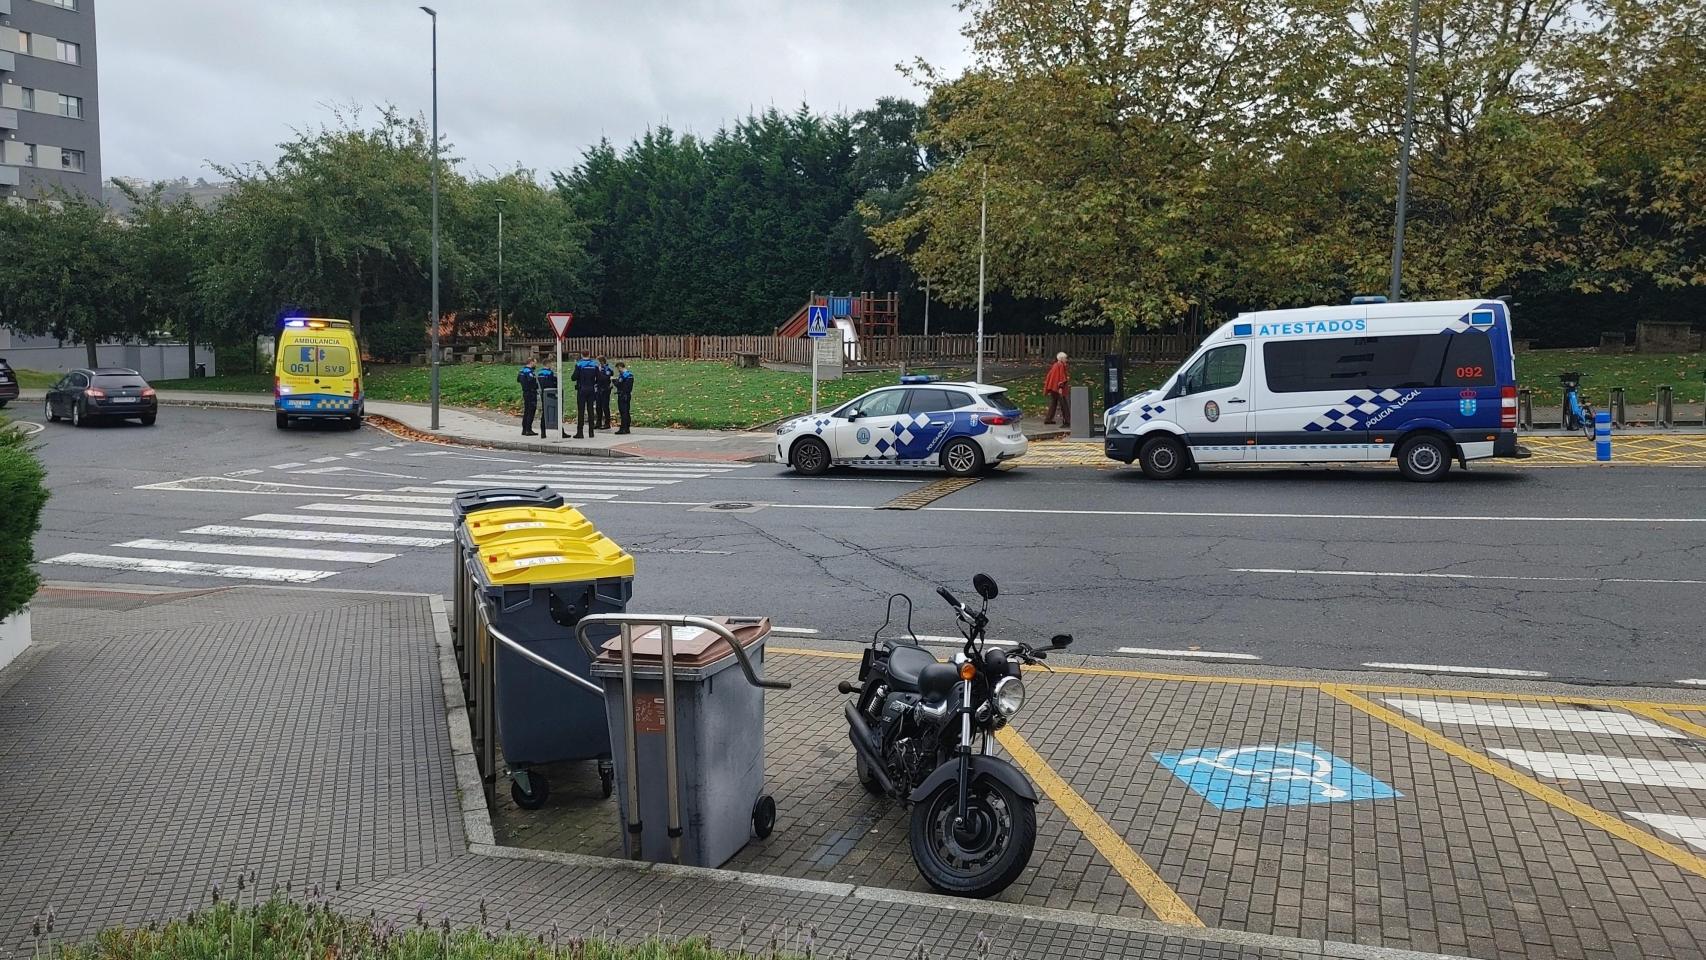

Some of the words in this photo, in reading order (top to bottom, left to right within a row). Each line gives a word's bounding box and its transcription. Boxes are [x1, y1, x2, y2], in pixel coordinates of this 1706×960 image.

[1259, 319, 1366, 336] ATESTADOS
[290, 364, 310, 373] 061
[1456, 366, 1483, 378] 092
[1365, 407, 1394, 428] POLICIA
[1397, 389, 1421, 407] LOCAL
